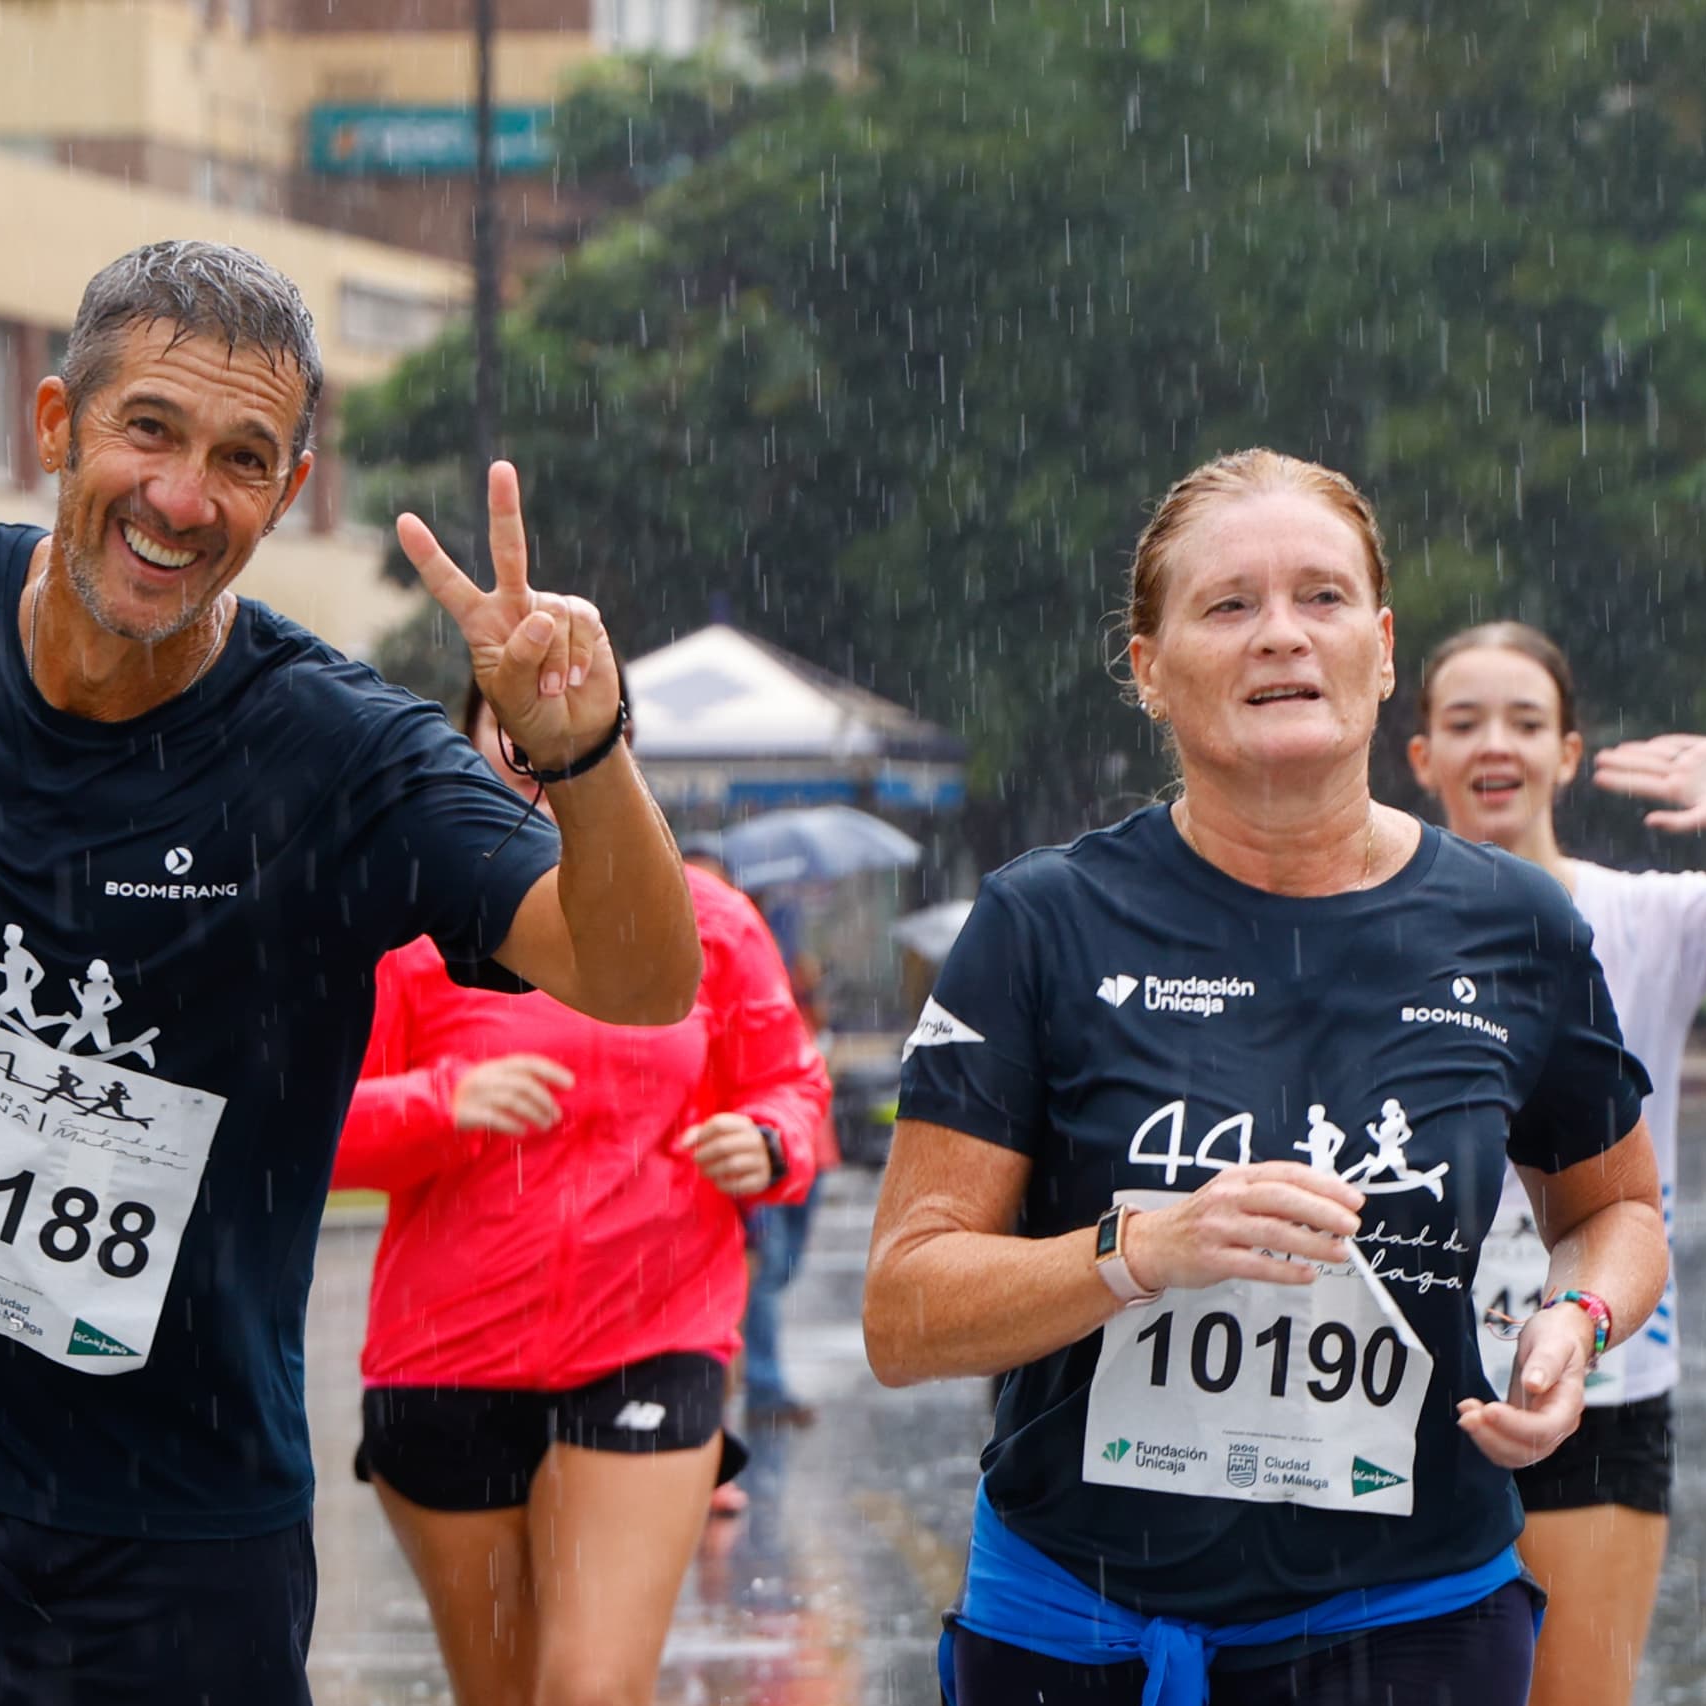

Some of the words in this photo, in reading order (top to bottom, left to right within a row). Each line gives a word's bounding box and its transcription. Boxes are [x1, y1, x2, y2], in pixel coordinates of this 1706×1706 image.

[105, 880, 239, 899] BOOMERANG
[1143, 975, 1256, 998] Fundación
[1143, 992, 1226, 1018] Unicaja
[1401, 1006, 1509, 1044] BOOMERANG
[1128, 1099, 1254, 1185] 44
[1137, 1310, 1408, 1407] 10190
[1135, 1440, 1208, 1463] Fundación
[1134, 1455, 1186, 1475] Unicaja
[1264, 1455, 1310, 1472] Ciudad
[1263, 1471, 1279, 1484] de
[1282, 1473, 1329, 1490] Málaga
